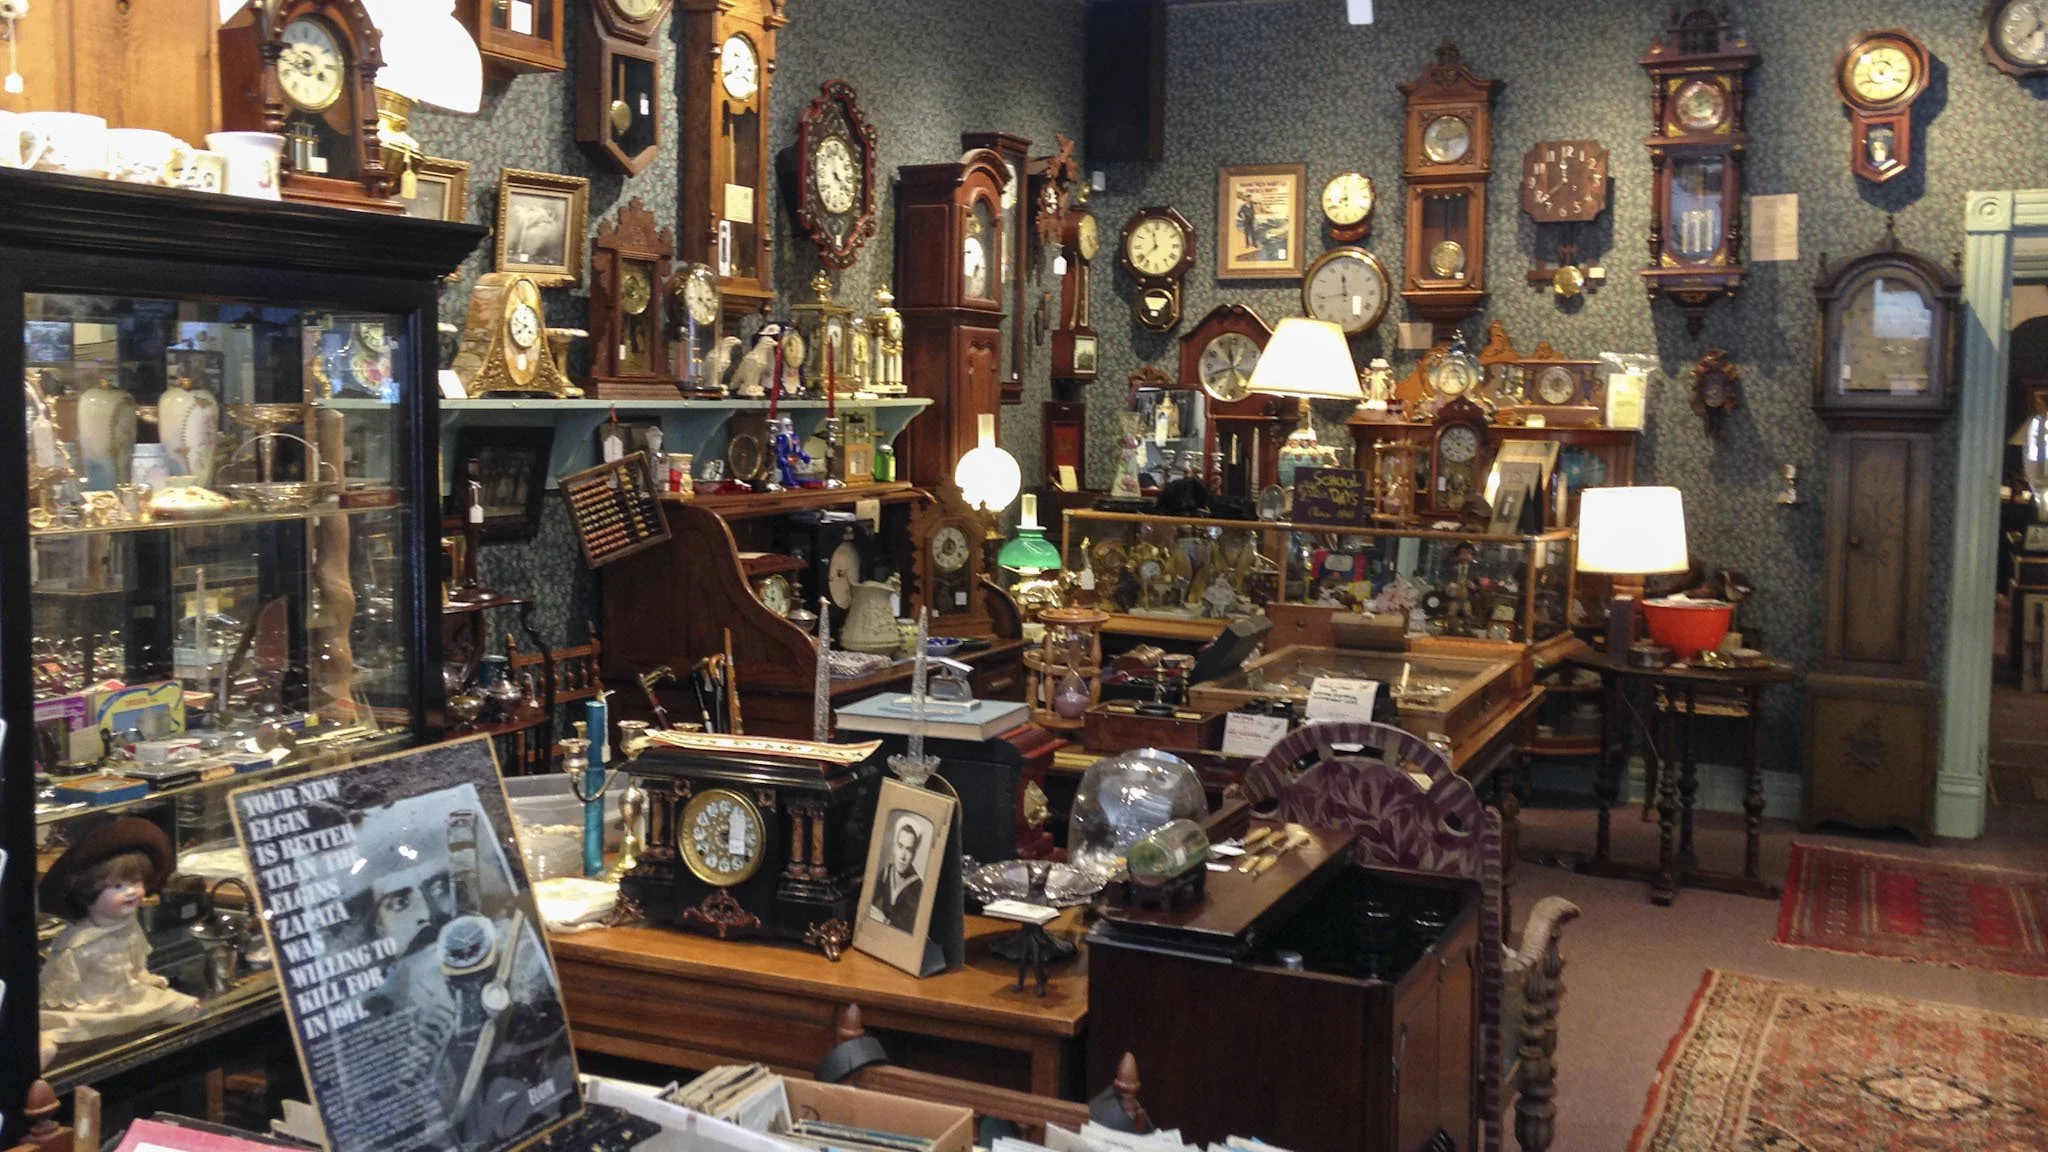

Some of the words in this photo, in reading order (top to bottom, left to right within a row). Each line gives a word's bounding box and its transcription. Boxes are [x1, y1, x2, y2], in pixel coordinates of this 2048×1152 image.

[1561, 145, 1575, 158] 12
[242, 788, 298, 816] YOUR
[297, 777, 341, 803] NEW
[248, 809, 311, 841] ELGIN
[254, 843, 279, 866] IS
[280, 823, 357, 858] BETTER
[262, 858, 317, 890] THAN
[324, 846, 361, 873] THE
[269, 878, 341, 915] ELGINS
[275, 901, 350, 940] ZAPATA
[281, 933, 326, 963] WAS
[289, 944, 371, 988] WILLING
[371, 936, 397, 961] TO
[296, 982, 345, 1015] KILL
[345, 967, 385, 996] FOR
[302, 1013, 329, 1040] IN
